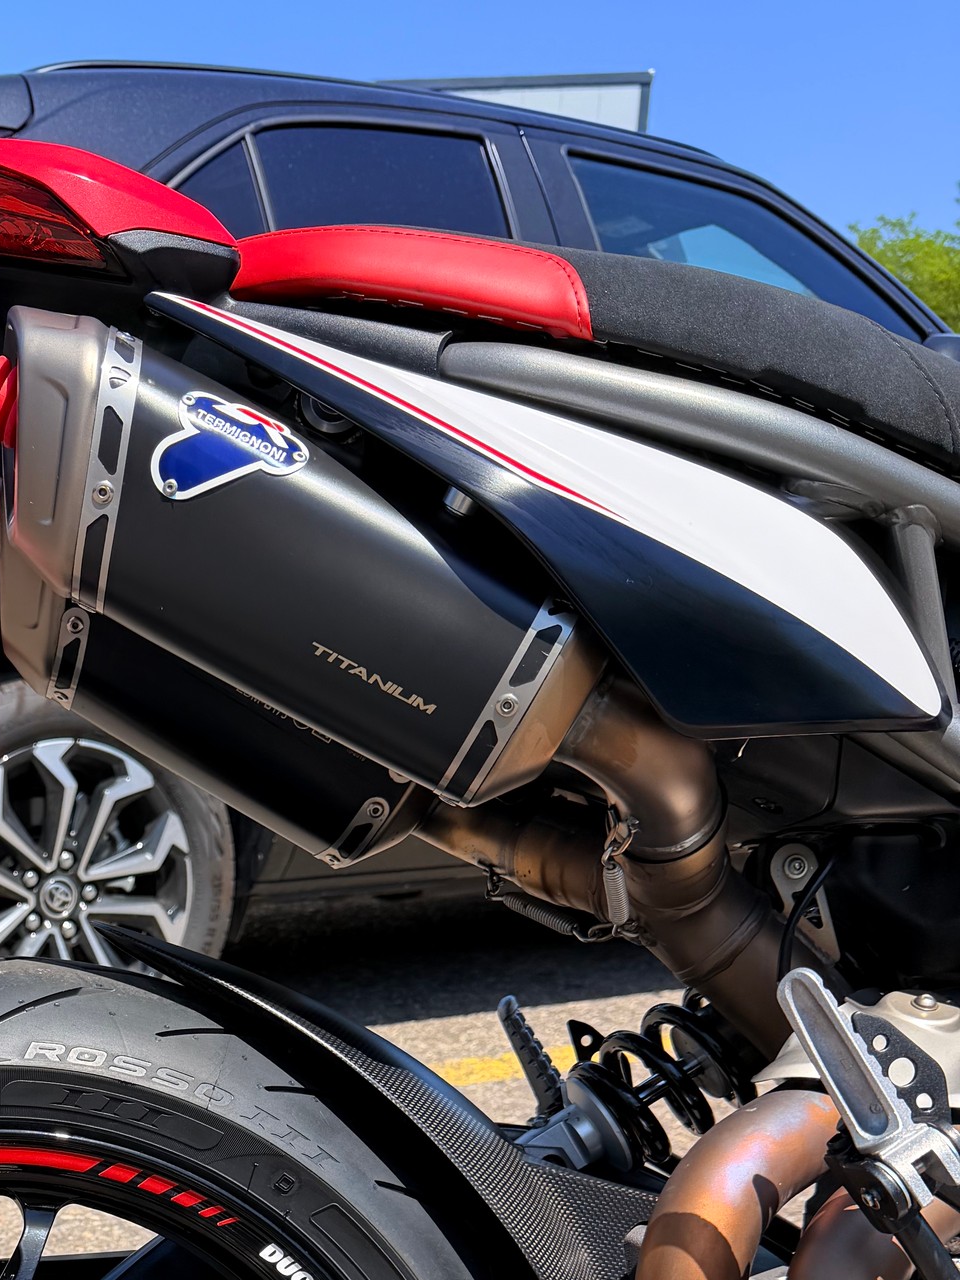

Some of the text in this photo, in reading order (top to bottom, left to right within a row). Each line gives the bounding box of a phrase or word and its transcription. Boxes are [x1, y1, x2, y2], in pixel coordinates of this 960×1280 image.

[198, 409, 287, 462] TERMIGNONI
[312, 641, 437, 714] TITANIUM
[24, 1042, 234, 1107] ROSSO
